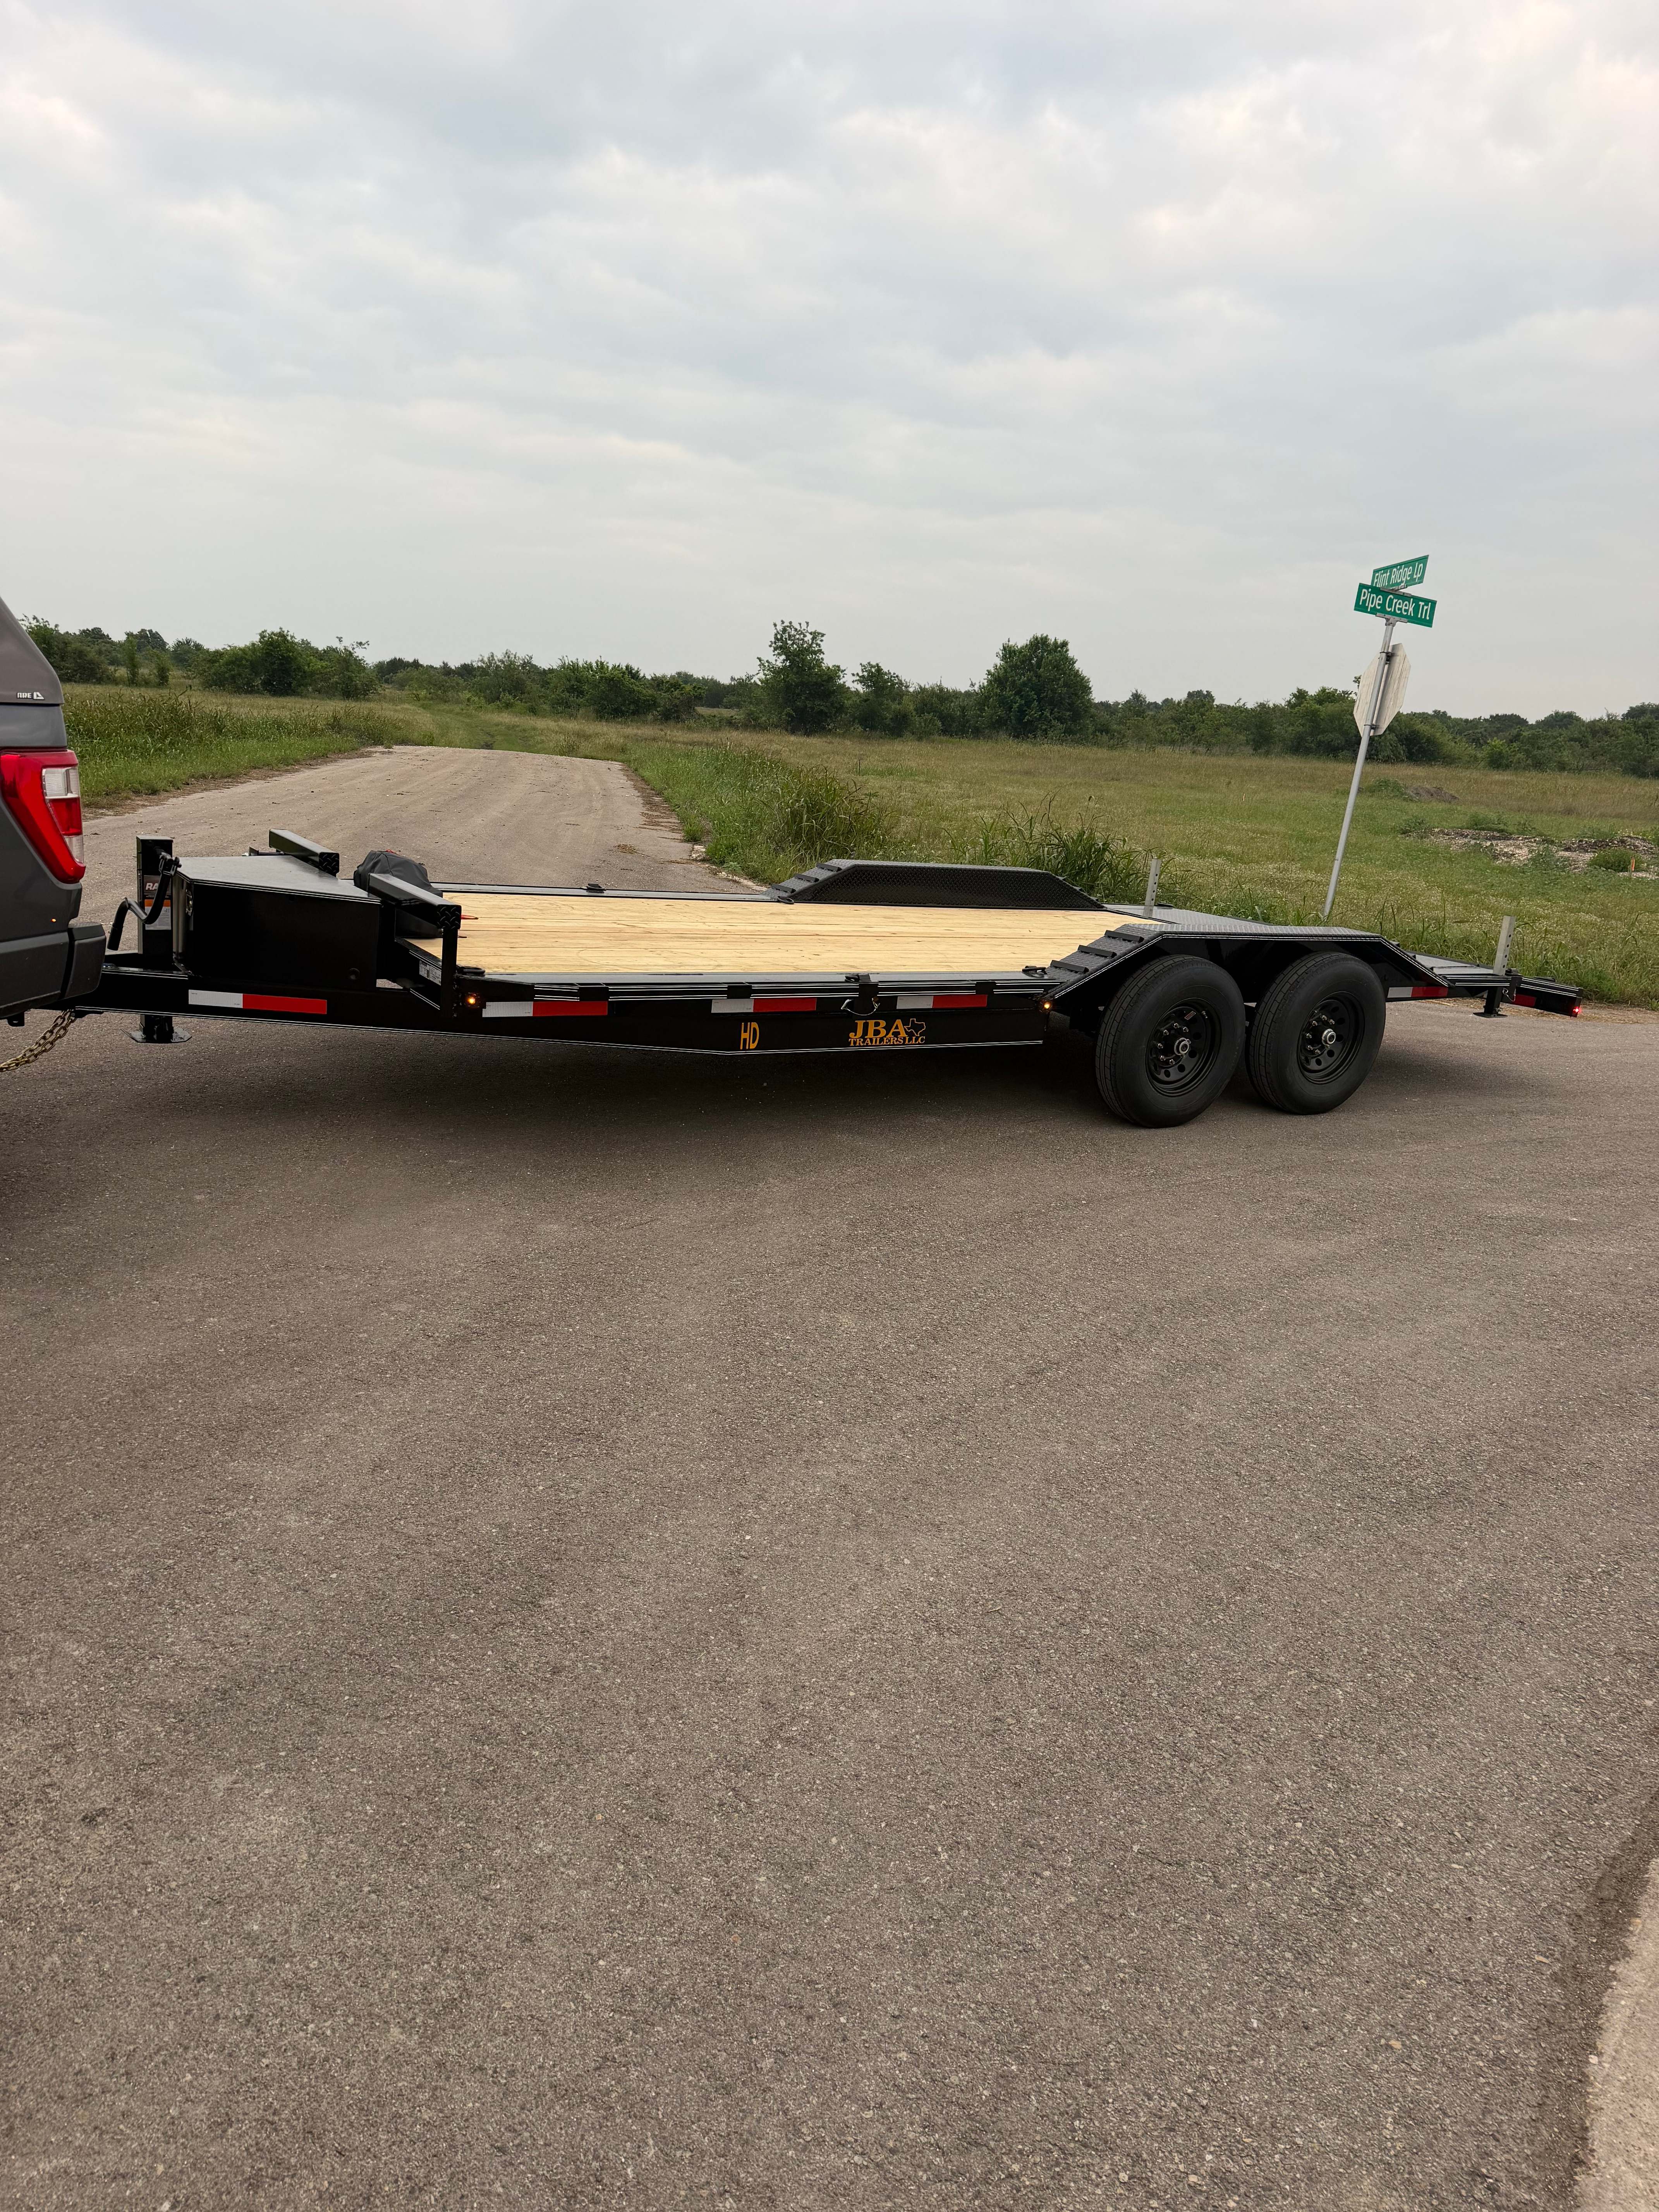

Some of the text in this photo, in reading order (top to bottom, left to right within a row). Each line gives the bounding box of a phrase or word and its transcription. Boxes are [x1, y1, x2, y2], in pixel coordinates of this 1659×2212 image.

[1373, 562, 1423, 587] Flint Ridge Lp
[1359, 588, 1431, 620] Pipe Creek Trl
[740, 1022, 759, 1050] HD
[848, 1036, 926, 1046] TRAILERS LLC
[849, 1019, 908, 1038] JBA
